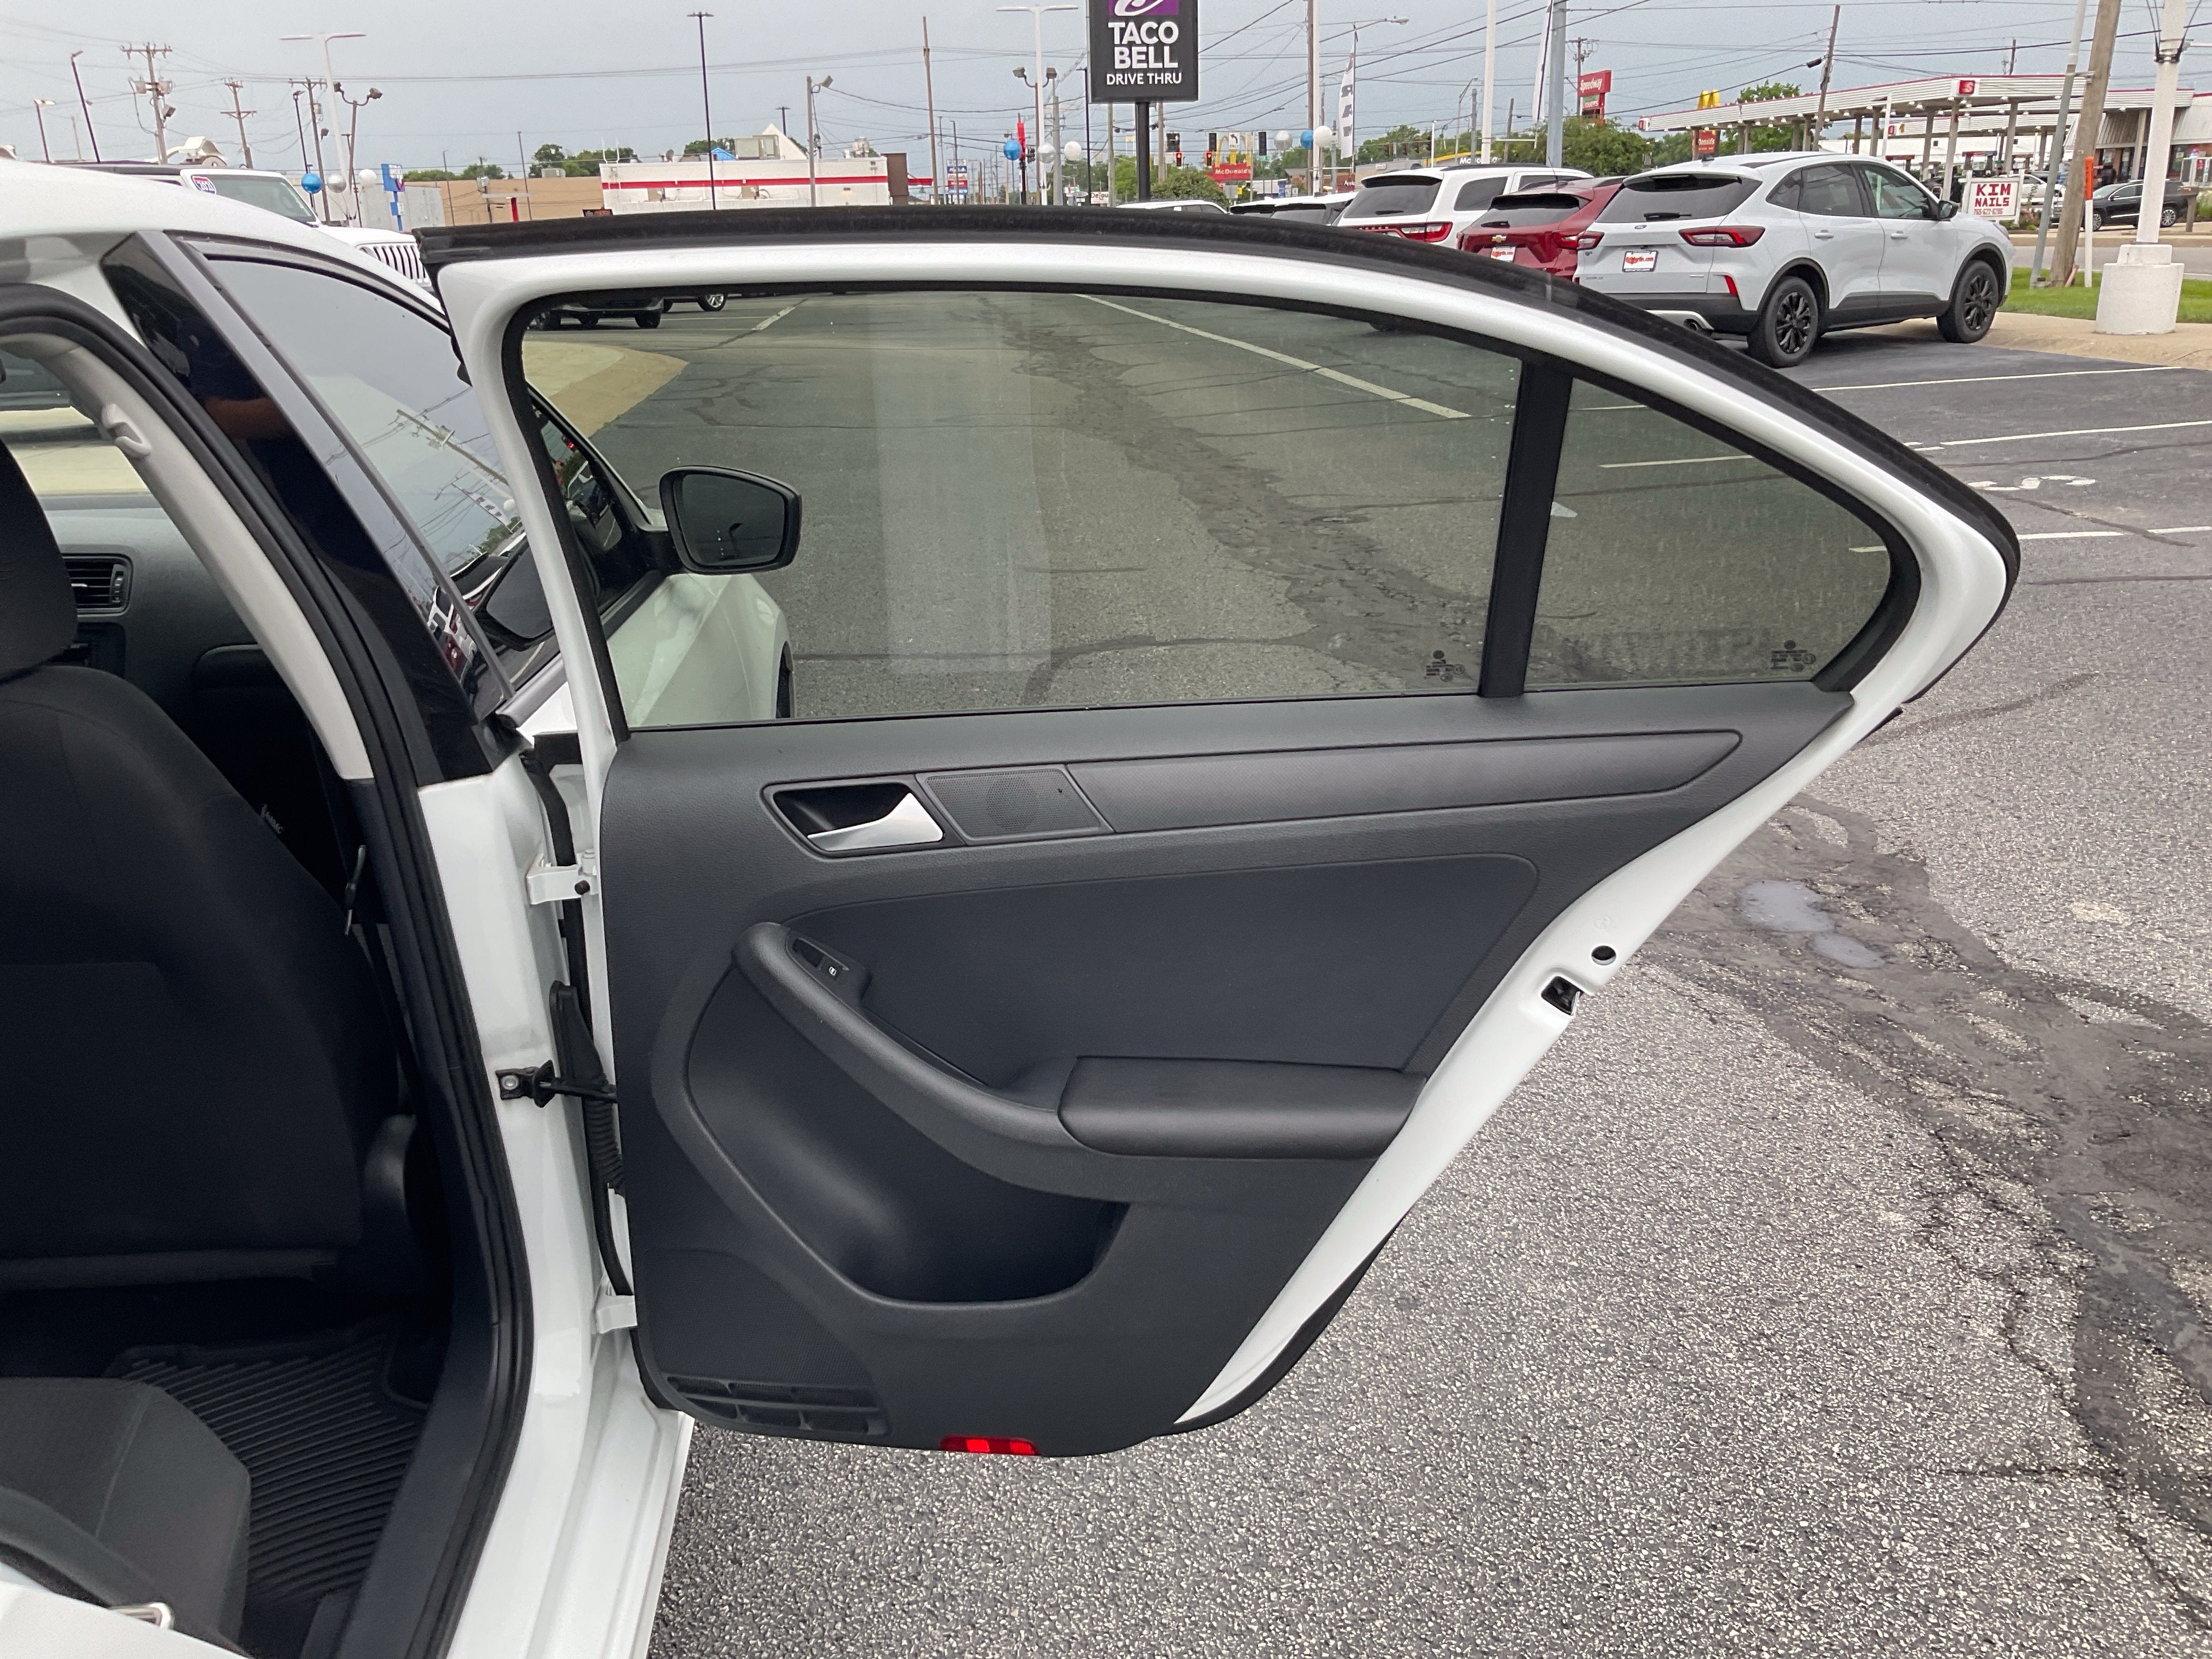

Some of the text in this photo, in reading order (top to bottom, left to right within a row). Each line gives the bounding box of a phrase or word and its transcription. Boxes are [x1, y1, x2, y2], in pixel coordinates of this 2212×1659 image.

[1108, 21, 1179, 44] TACO
[1114, 46, 1178, 69] BELL
[1106, 72, 1182, 86] DRIVE THRU
[1580, 77, 1602, 93] Speedway
[1976, 183, 2011, 196] KIM
[1975, 197, 2010, 207] NAILS
